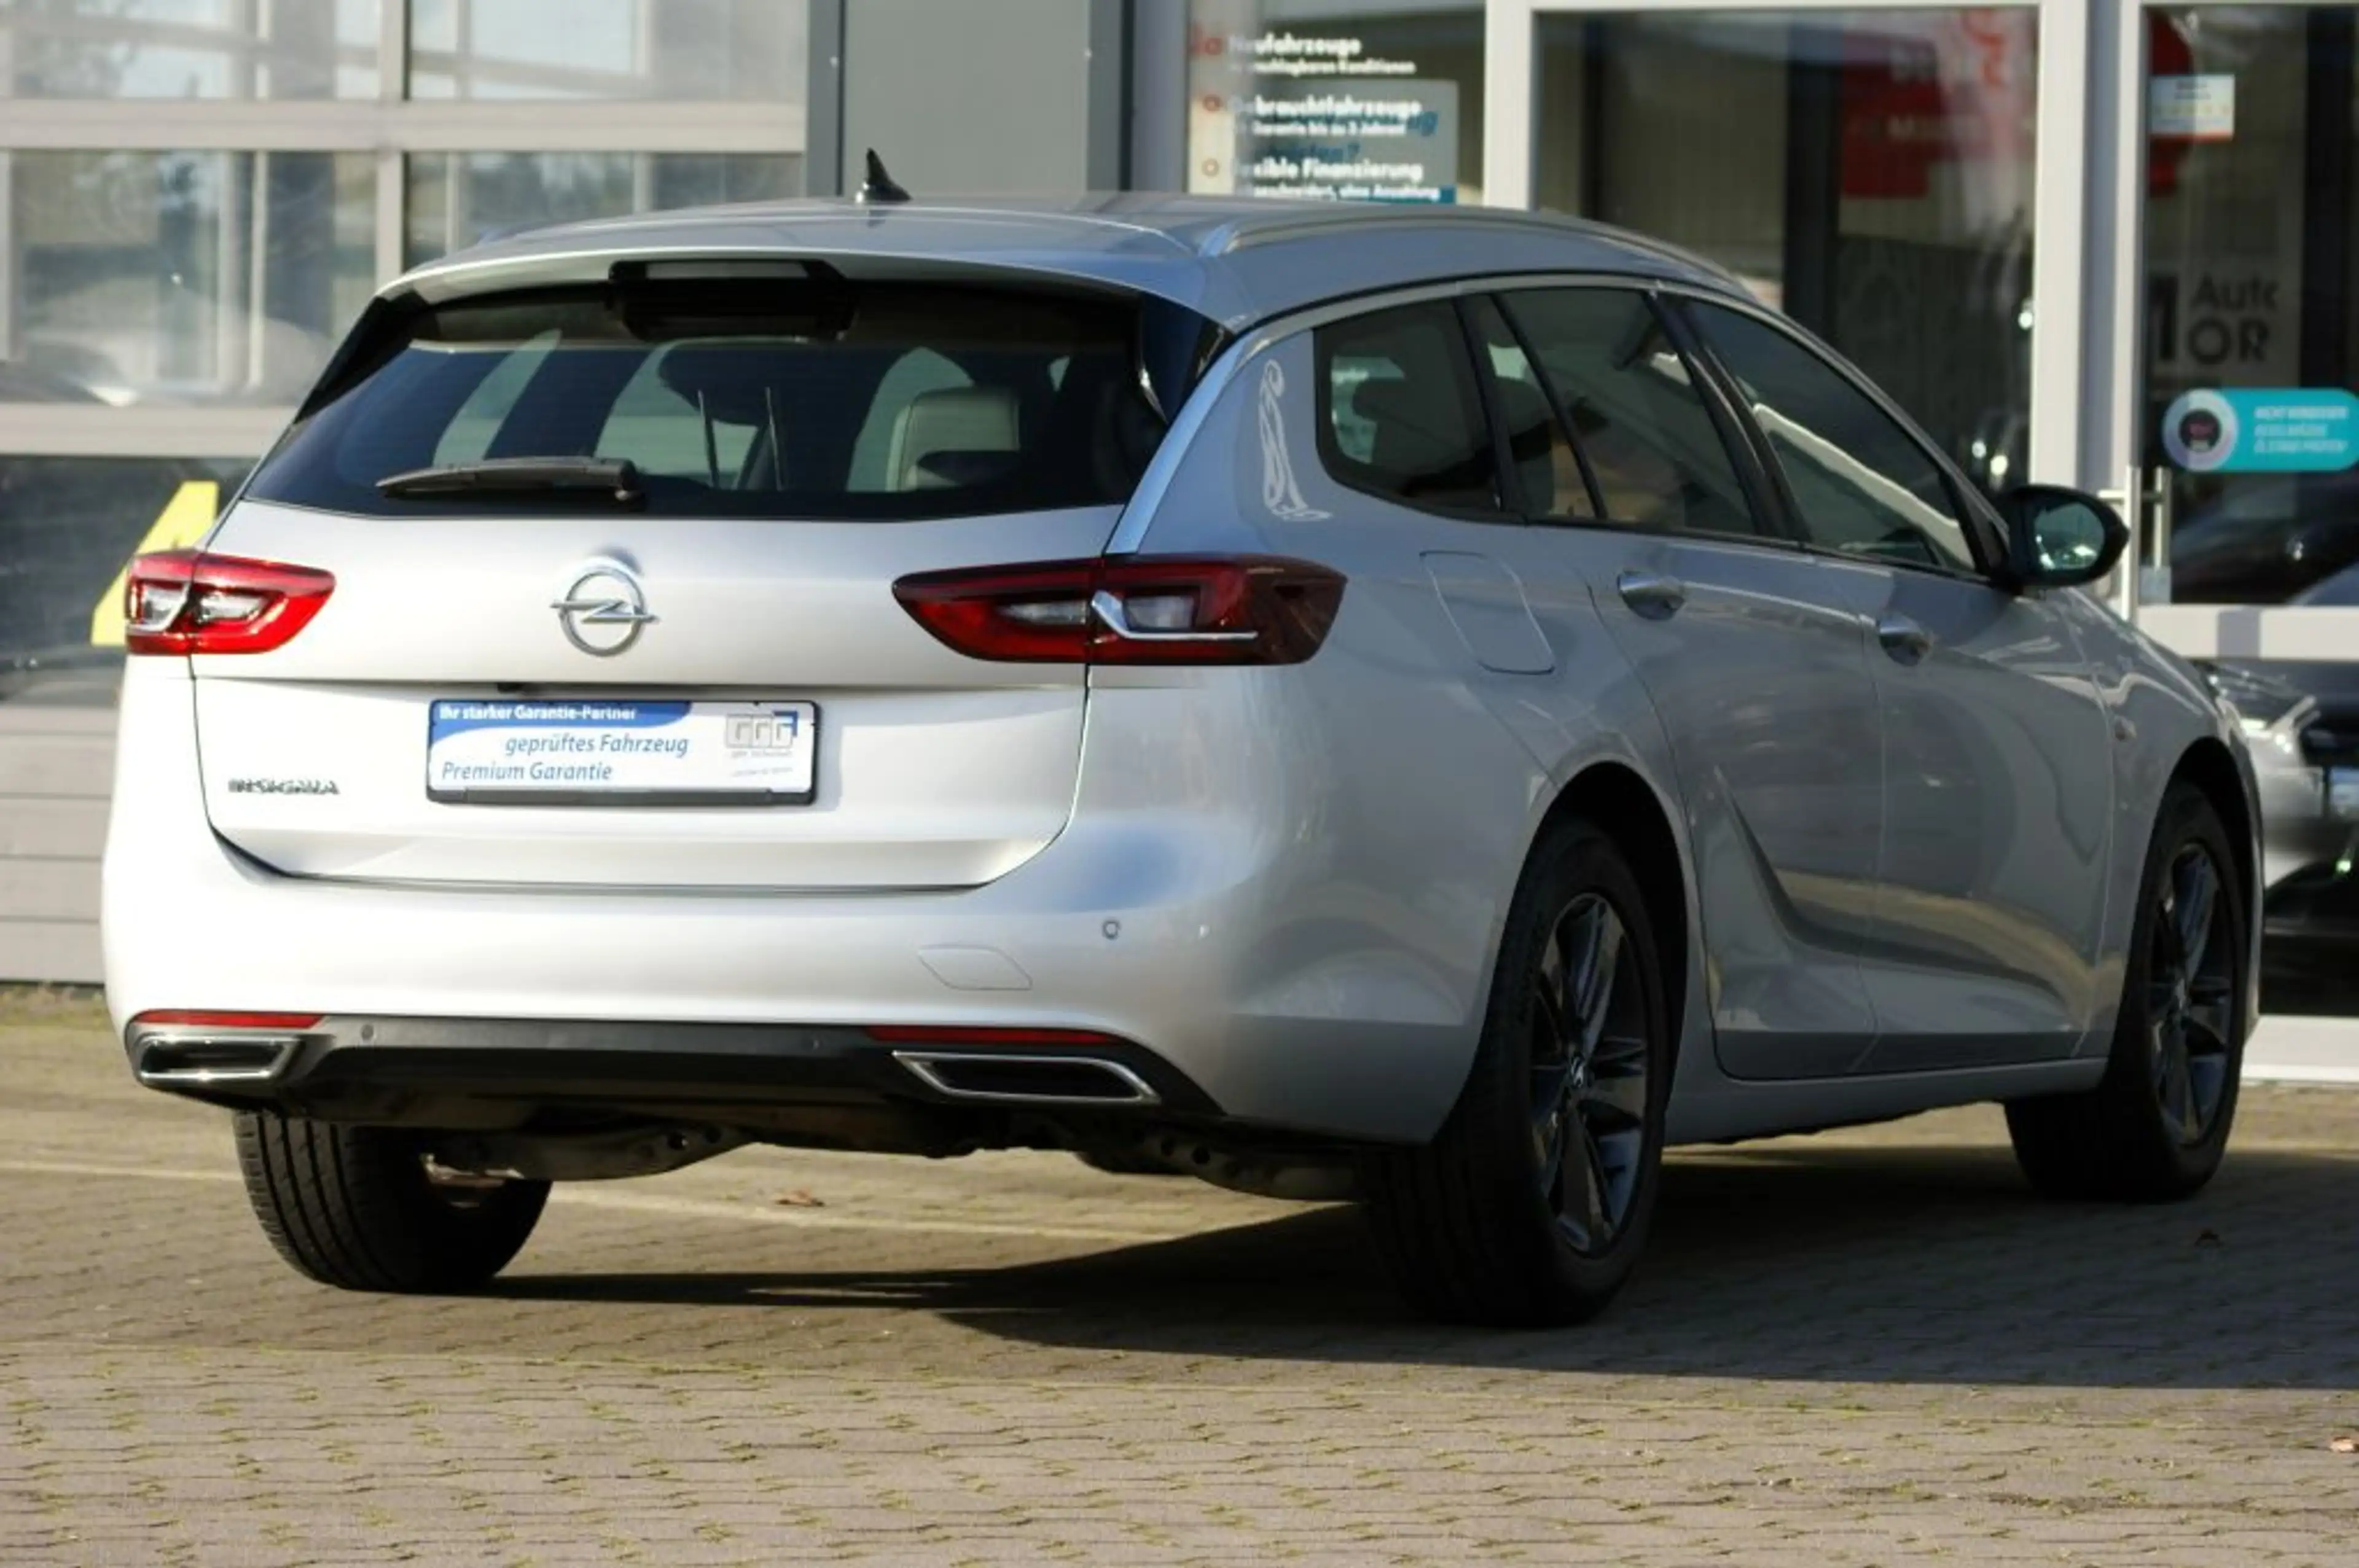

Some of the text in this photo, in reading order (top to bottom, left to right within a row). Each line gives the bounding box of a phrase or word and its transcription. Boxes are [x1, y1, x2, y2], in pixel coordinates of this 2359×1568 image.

[439, 706, 458, 720] Ihr
[463, 705, 511, 720] starker
[506, 733, 689, 758] geprüftes Fahrzeug
[442, 761, 612, 780] Premium Garantie
